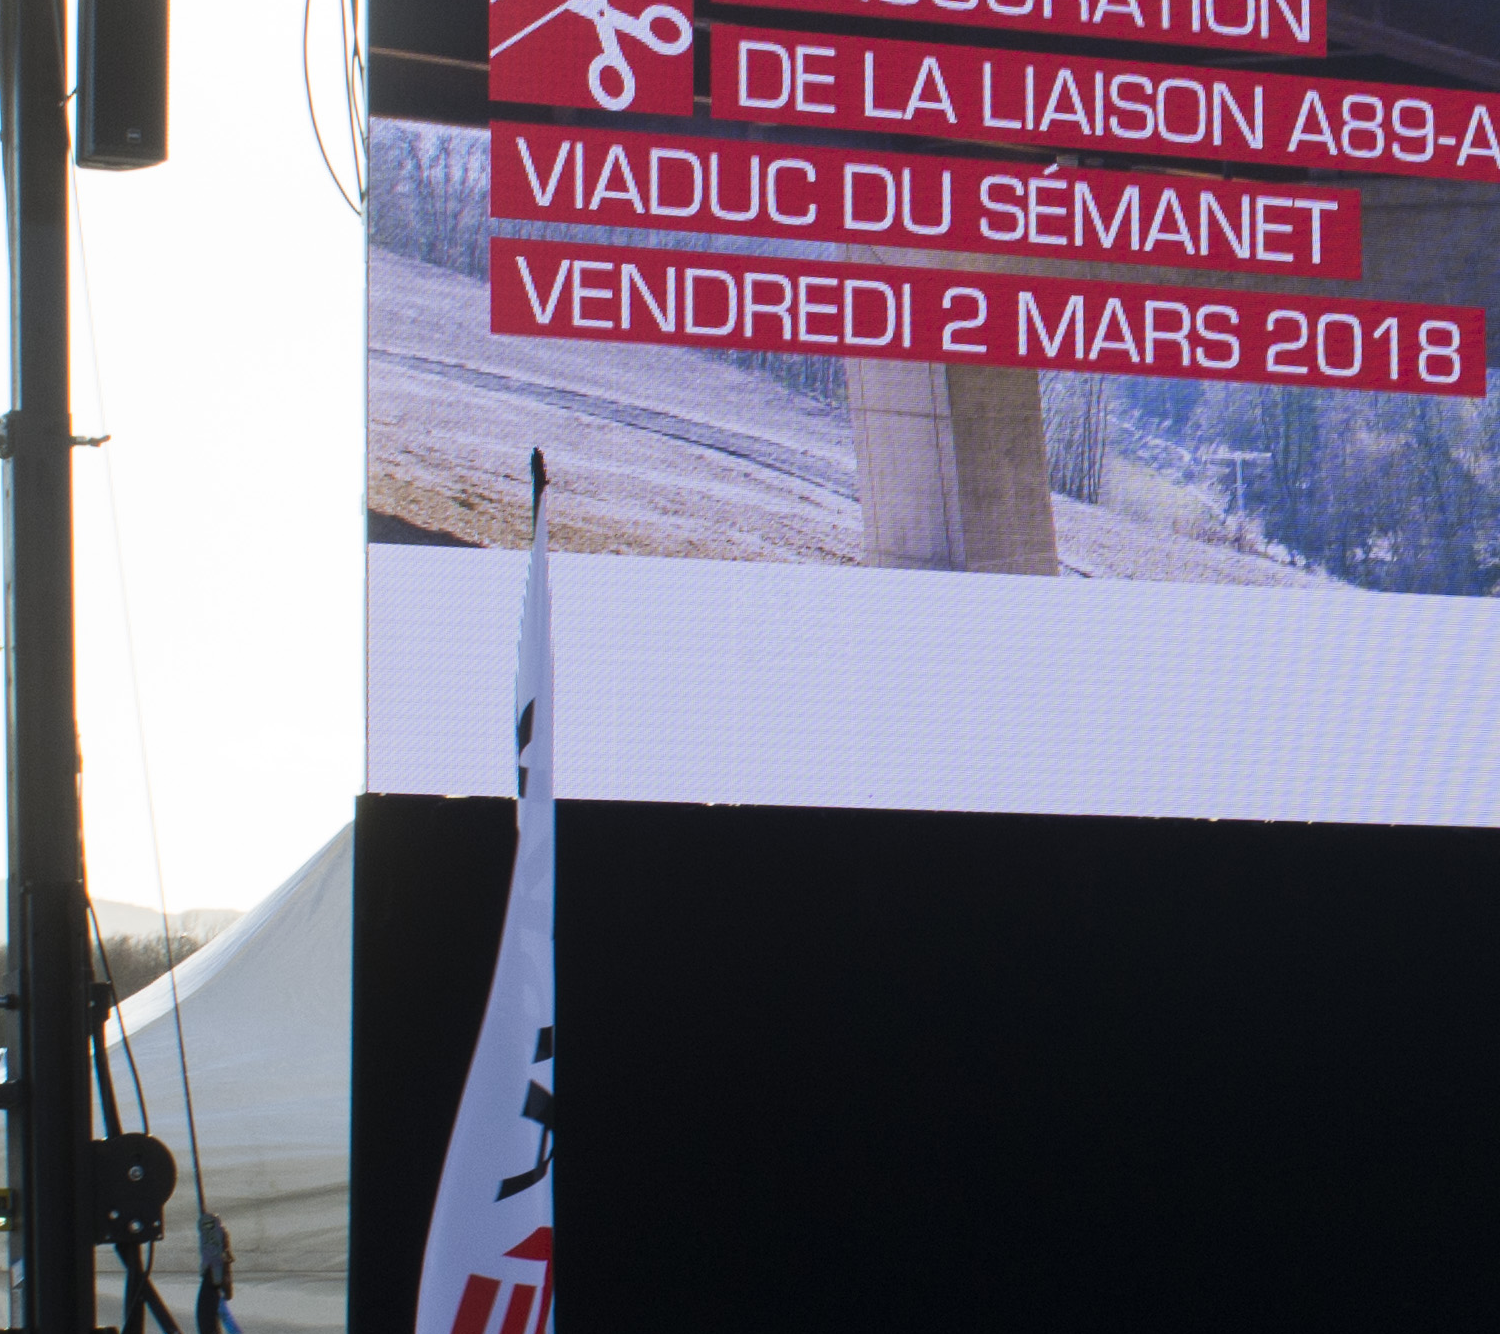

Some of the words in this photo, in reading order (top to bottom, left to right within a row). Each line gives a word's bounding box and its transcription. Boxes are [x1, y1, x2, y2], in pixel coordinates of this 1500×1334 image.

[739, 41, 835, 113] DE
[865, 51, 956, 123] LA
[983, 63, 1263, 149] LIAISON
[517, 138, 816, 225] VIADUC
[844, 164, 951, 235] DU
[979, 164, 1338, 264] SÉMANET
[515, 256, 912, 349] VENDREDI
[942, 287, 987, 352] 2
[1018, 292, 1240, 368] MARS
[1267, 310, 1460, 383] 2018
